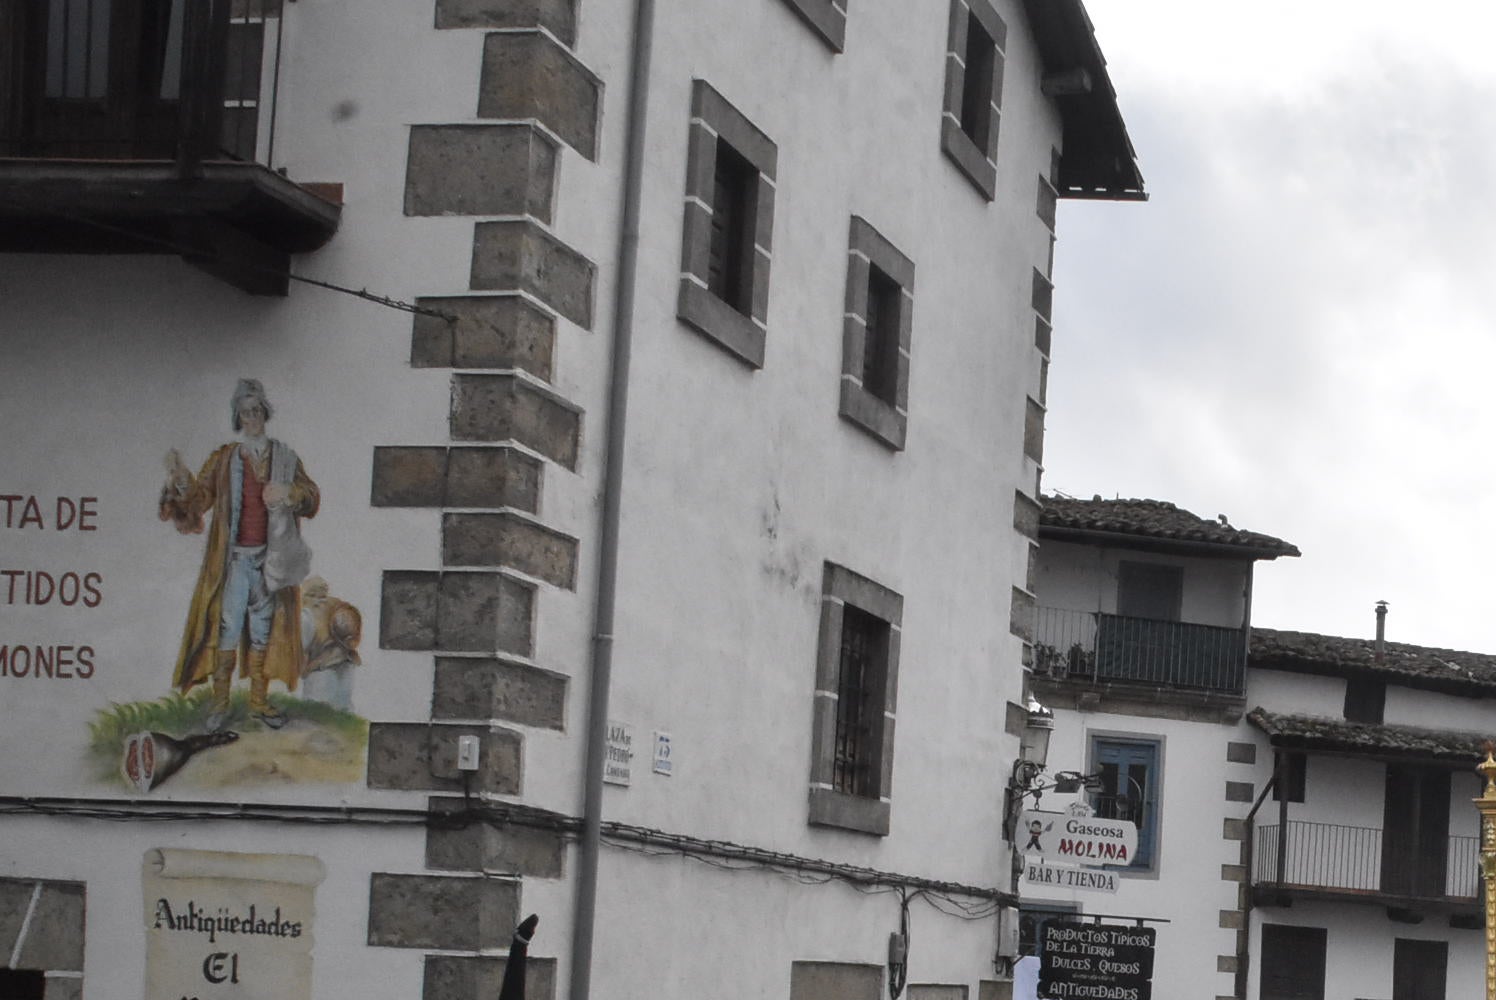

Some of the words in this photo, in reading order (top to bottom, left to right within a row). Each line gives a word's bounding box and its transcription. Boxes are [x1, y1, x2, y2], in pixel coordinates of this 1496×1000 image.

[56, 496, 98, 531] DE
[1, 570, 103, 608] TIDOS
[1066, 820, 1124, 839] Gaseosa
[1058, 838, 1127, 861] MOLINA
[1029, 866, 1053, 883] BAR
[1057, 870, 1065, 884] Y
[1067, 871, 1115, 890] TIENDA
[1046, 940, 1061, 952] DE
[1047, 927, 1108, 944] PRODUCTOS
[203, 952, 239, 984] El
[1052, 955, 1091, 970] DULCES
[1099, 959, 1140, 974] QUESOS
